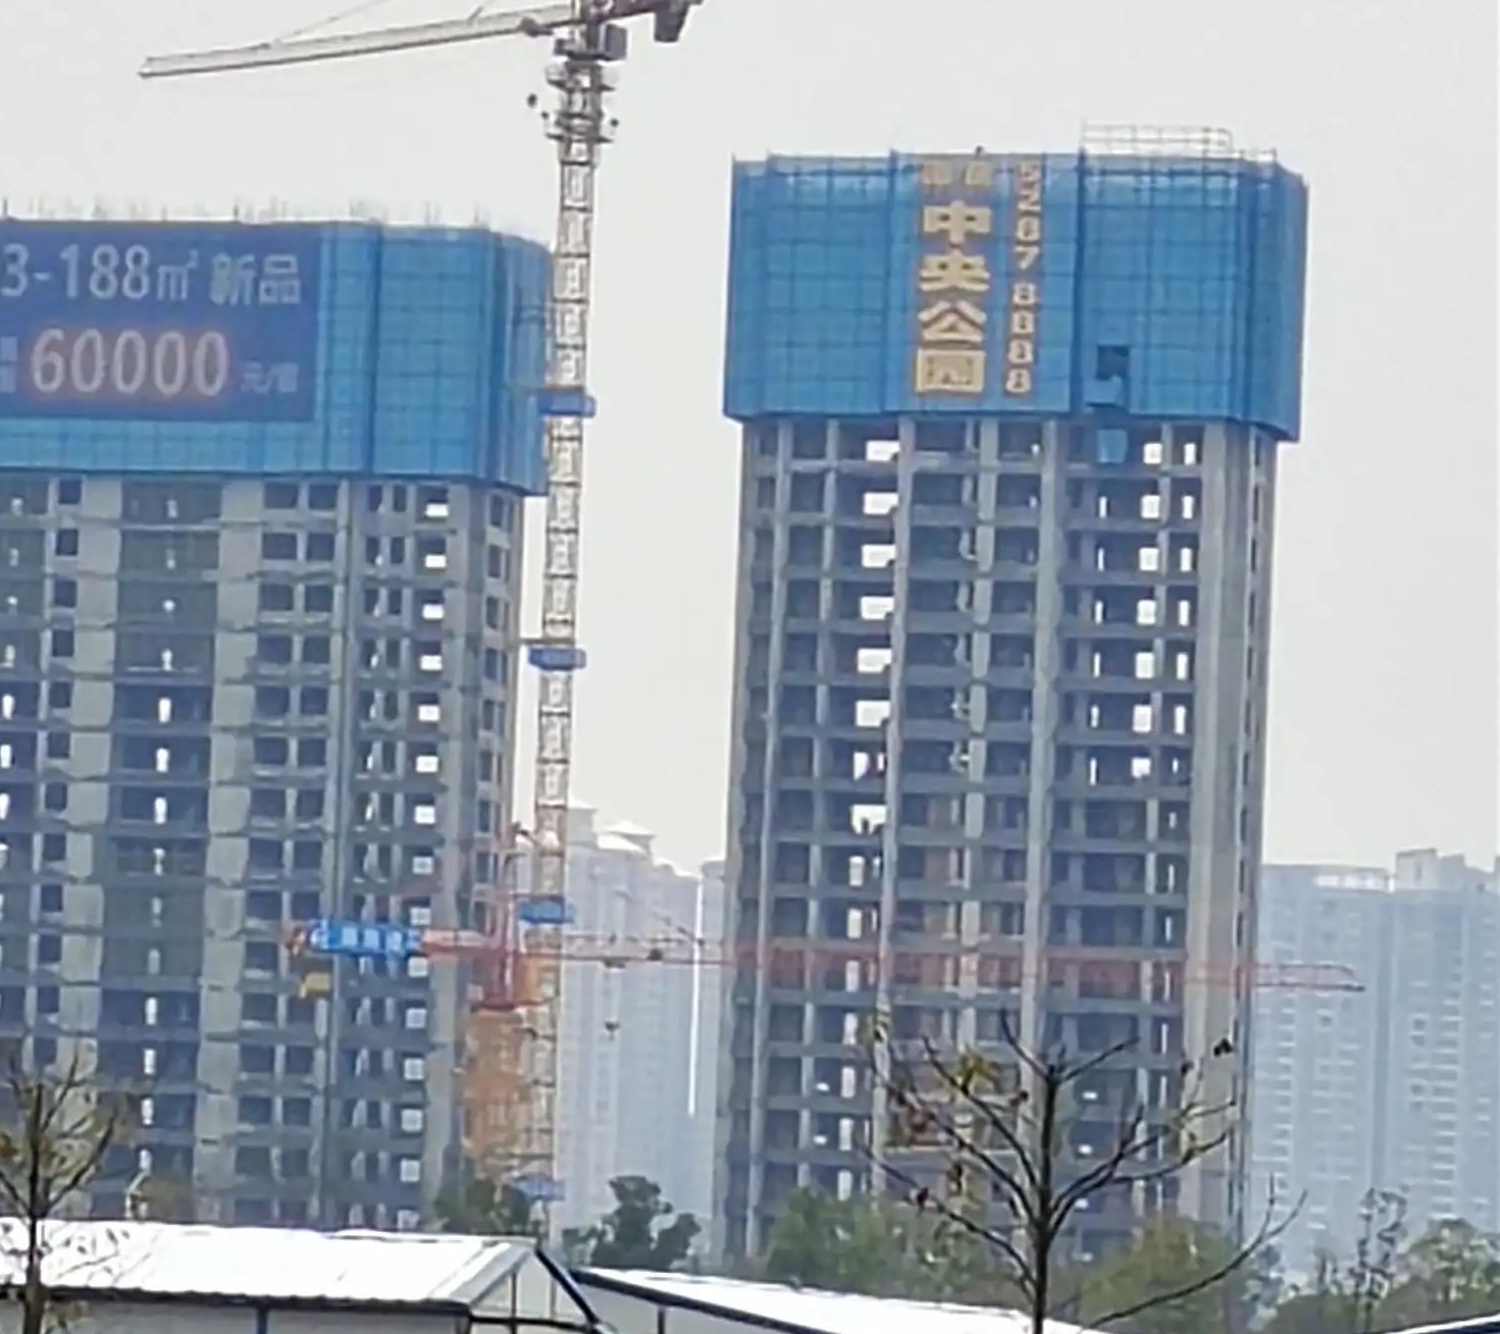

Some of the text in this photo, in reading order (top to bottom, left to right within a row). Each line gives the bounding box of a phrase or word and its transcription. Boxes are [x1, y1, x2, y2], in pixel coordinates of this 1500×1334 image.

[31, 328, 230, 396] 60000
[914, 199, 991, 394] 中央公园
